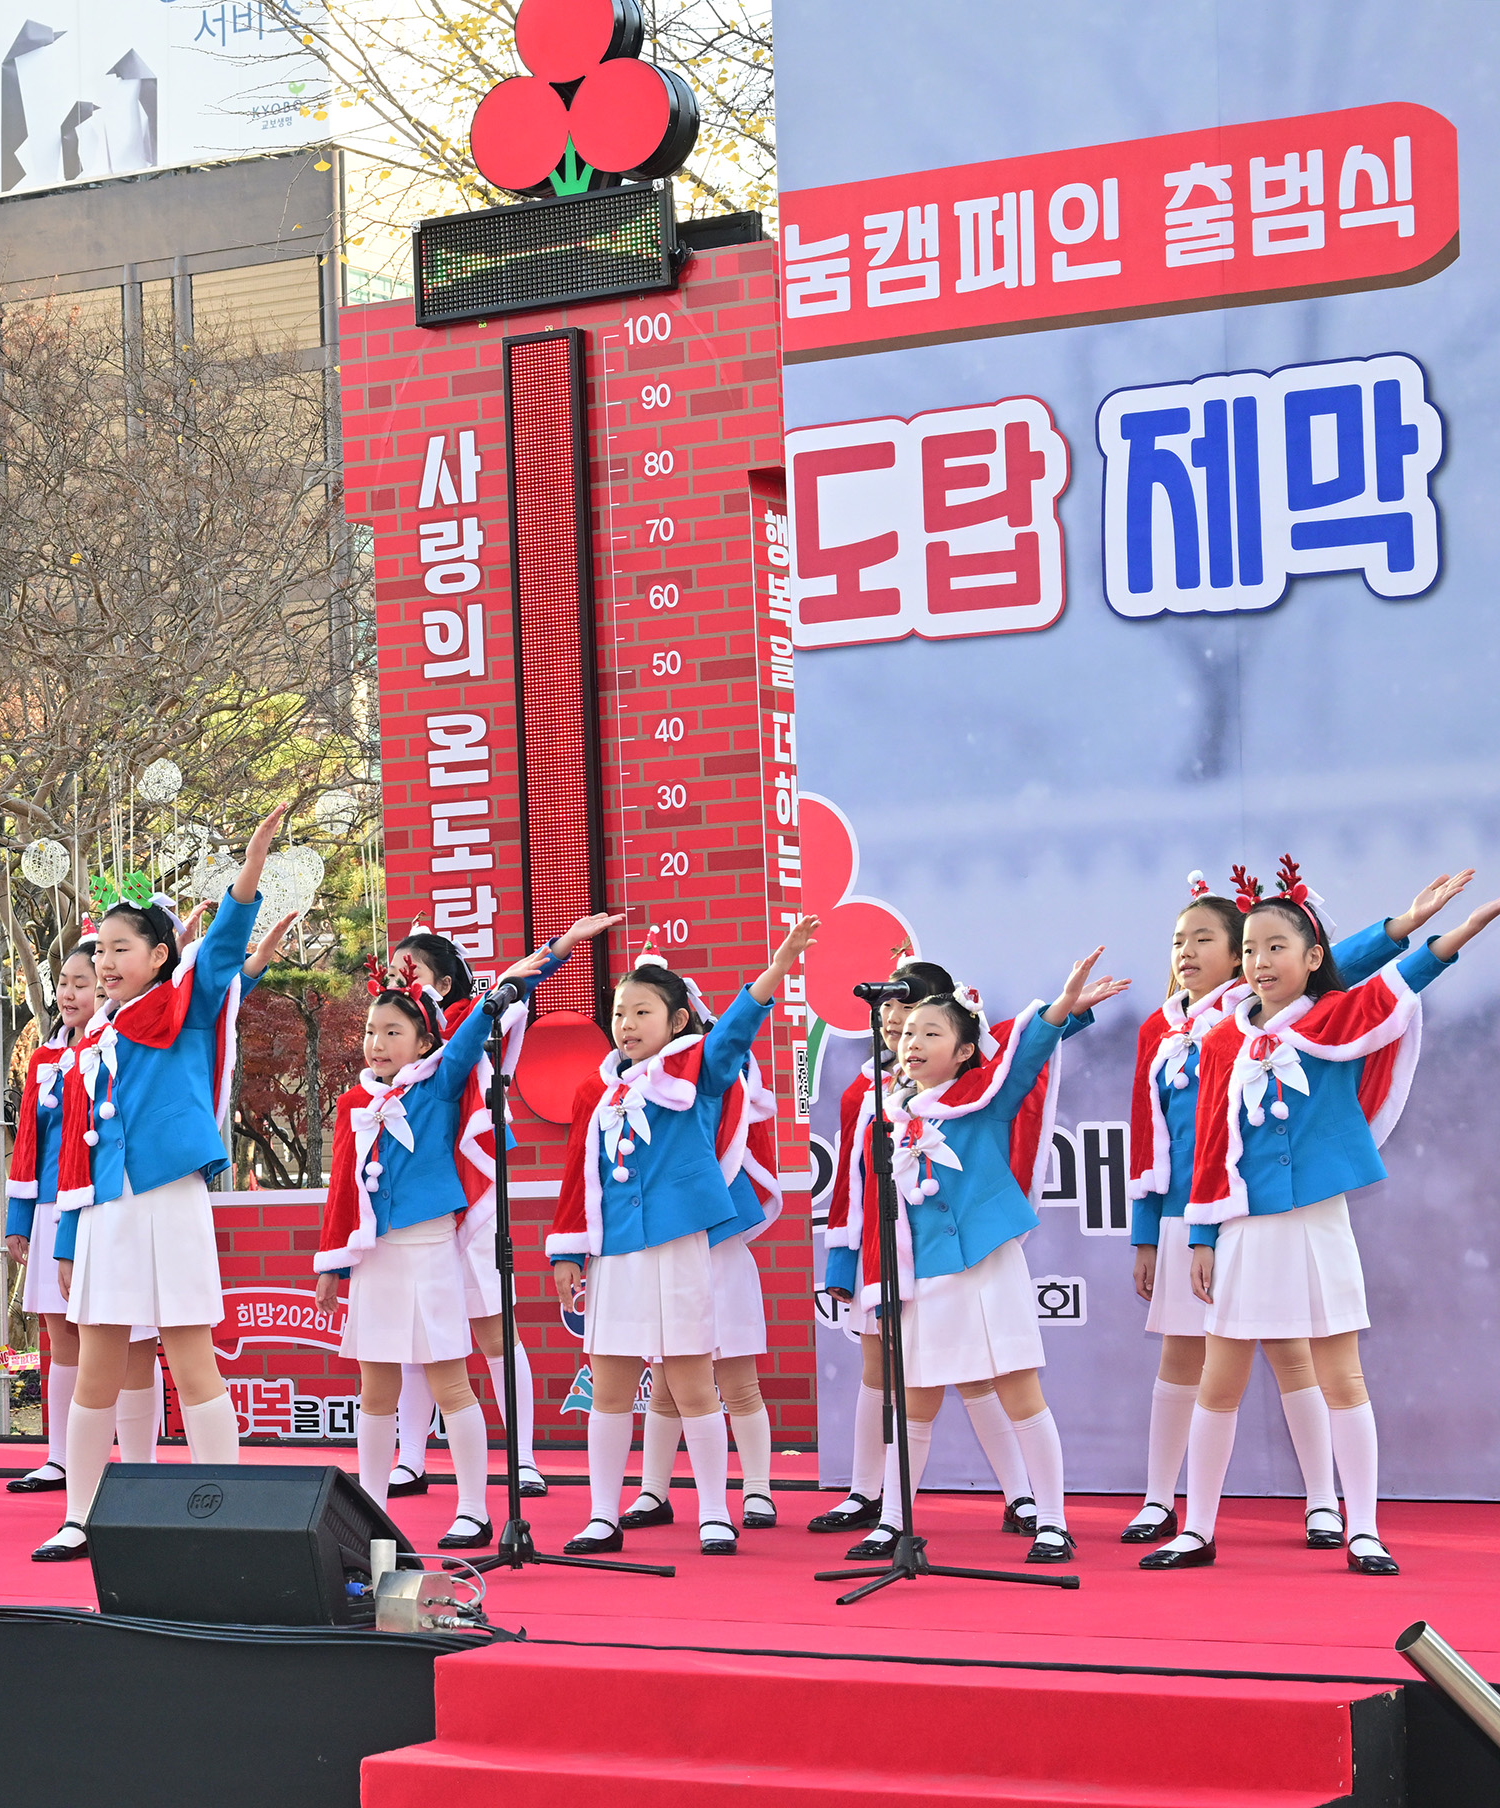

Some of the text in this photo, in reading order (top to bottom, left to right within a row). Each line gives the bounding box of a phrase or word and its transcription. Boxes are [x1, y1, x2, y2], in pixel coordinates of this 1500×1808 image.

[261, 116, 293, 130] 교보생명
[784, 134, 1417, 319] 눔캠페인 출범식
[624, 312, 672, 345] 100
[641, 383, 672, 410] 90
[643, 450, 674, 477] 80
[791, 377, 1421, 626] 도탑 제막
[645, 517, 675, 543] 70
[417, 429, 486, 680] 사랑의
[649, 583, 680, 610] 60
[652, 650, 682, 676] 50
[654, 717, 685, 743] 40
[656, 784, 687, 811] 30
[659, 851, 689, 877] 20
[662, 918, 689, 944] 10
[190, 1494, 221, 1508] RCF
